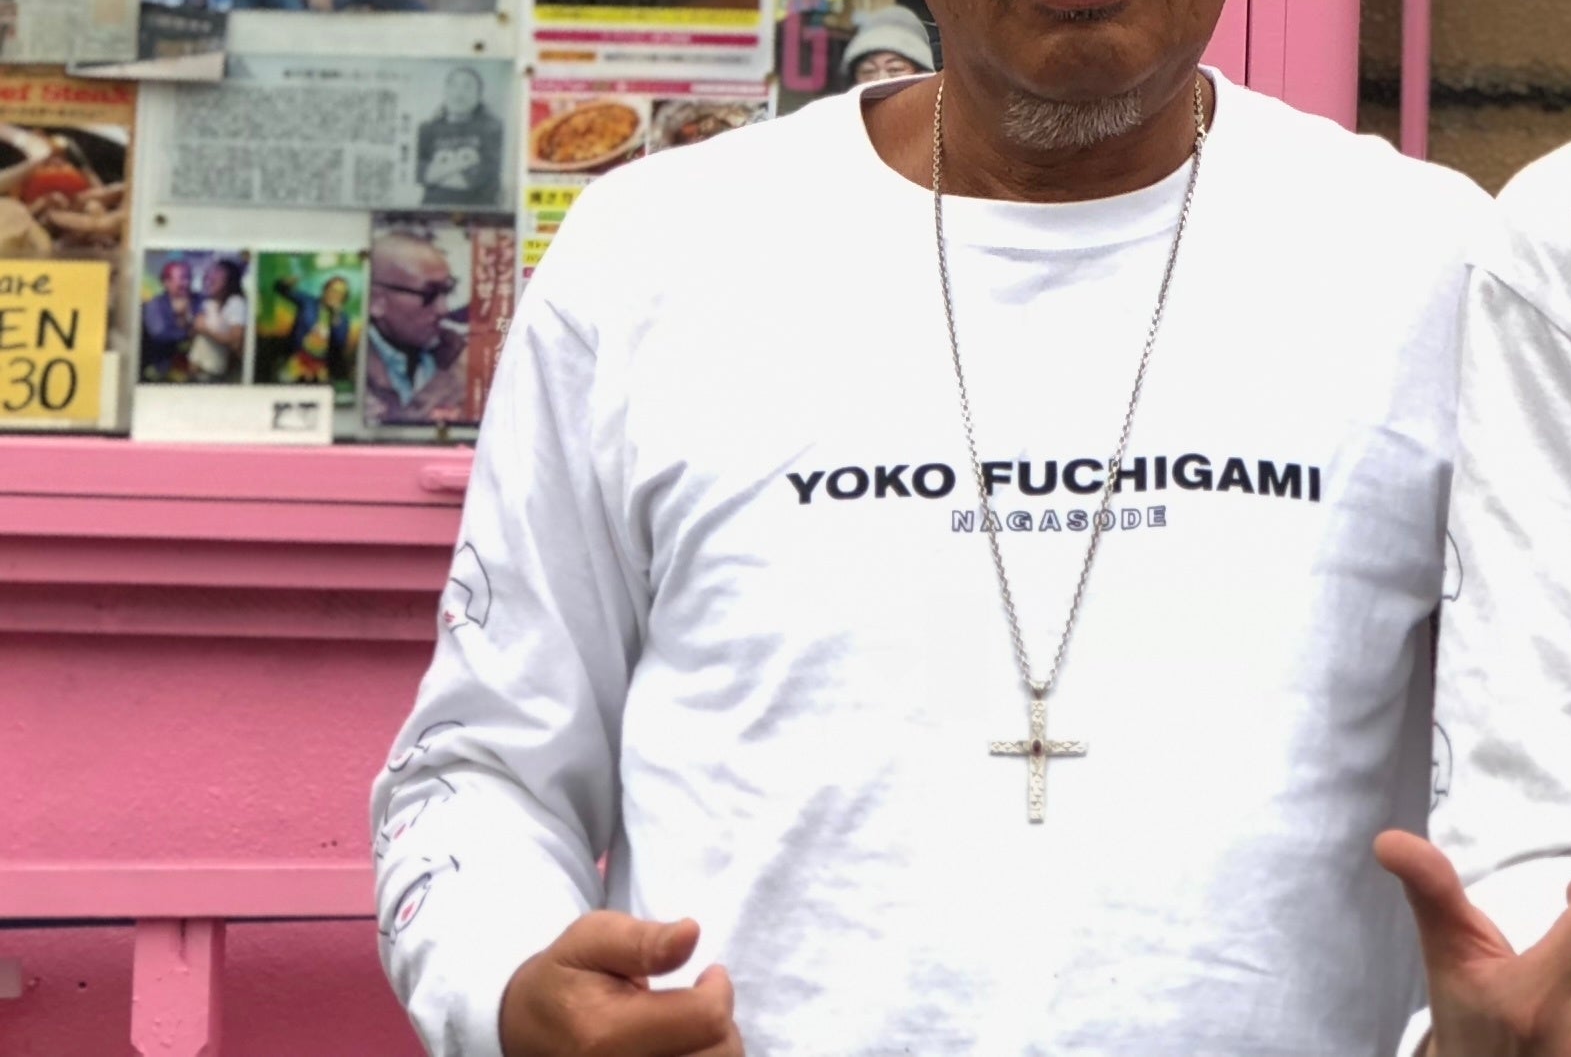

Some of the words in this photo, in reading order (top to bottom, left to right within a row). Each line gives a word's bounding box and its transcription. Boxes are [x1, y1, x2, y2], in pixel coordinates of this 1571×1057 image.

[787, 462, 956, 504] YOKO
[982, 453, 1321, 502] FUCHIGAMI
[951, 505, 1168, 533] NAGASODE
